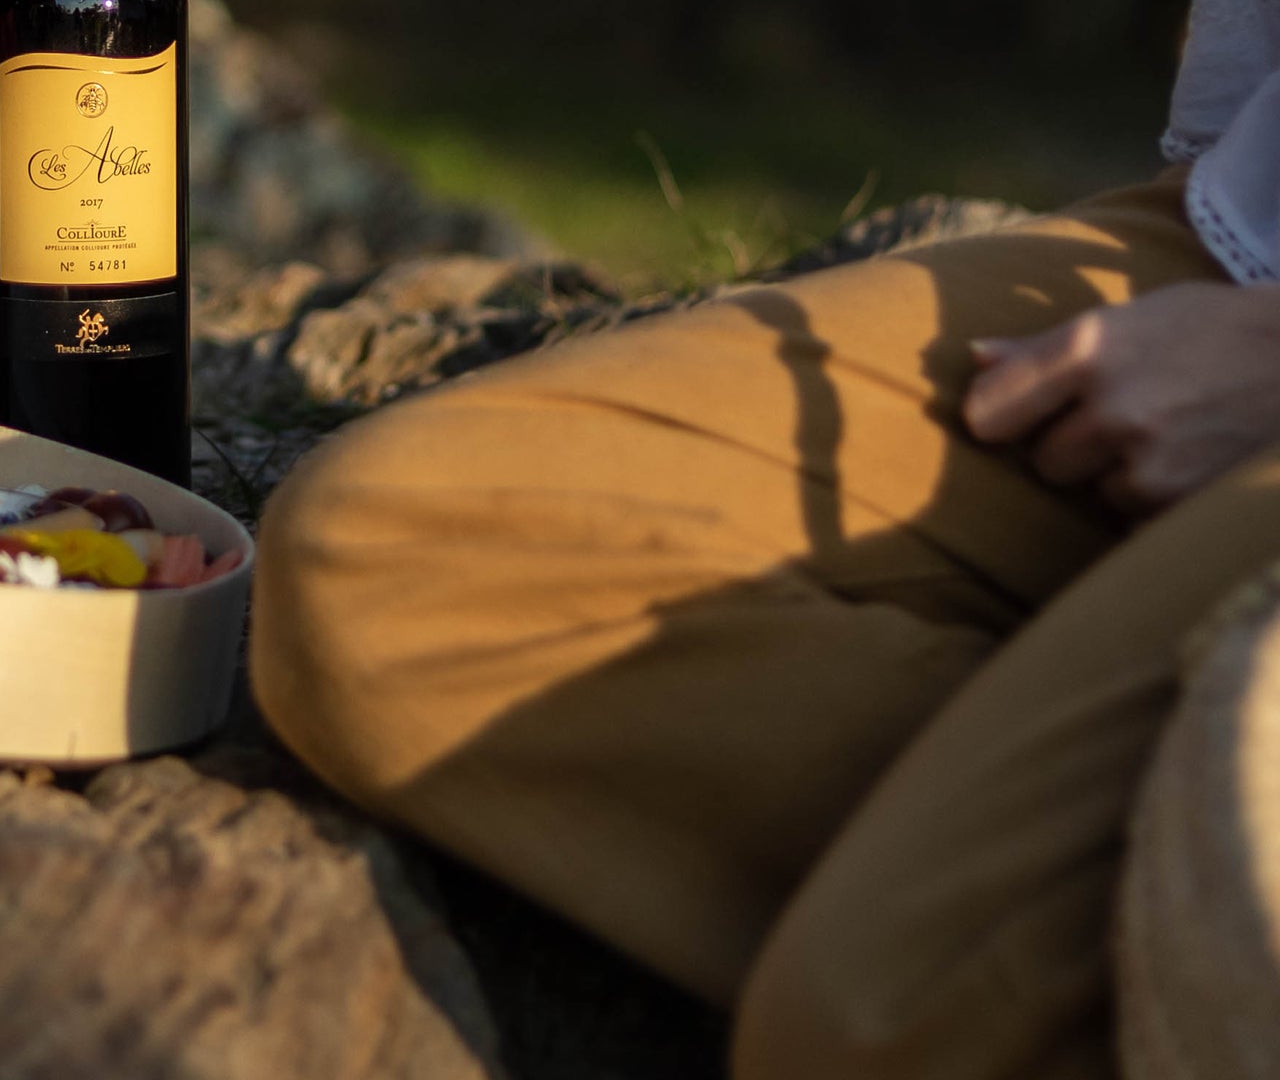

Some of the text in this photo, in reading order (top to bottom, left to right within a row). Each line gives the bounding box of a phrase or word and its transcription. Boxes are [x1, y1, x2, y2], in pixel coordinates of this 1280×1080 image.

[62, 125, 151, 184] Abelles
[80, 199, 103, 209] 2017
[89, 260, 126, 271] 54781
